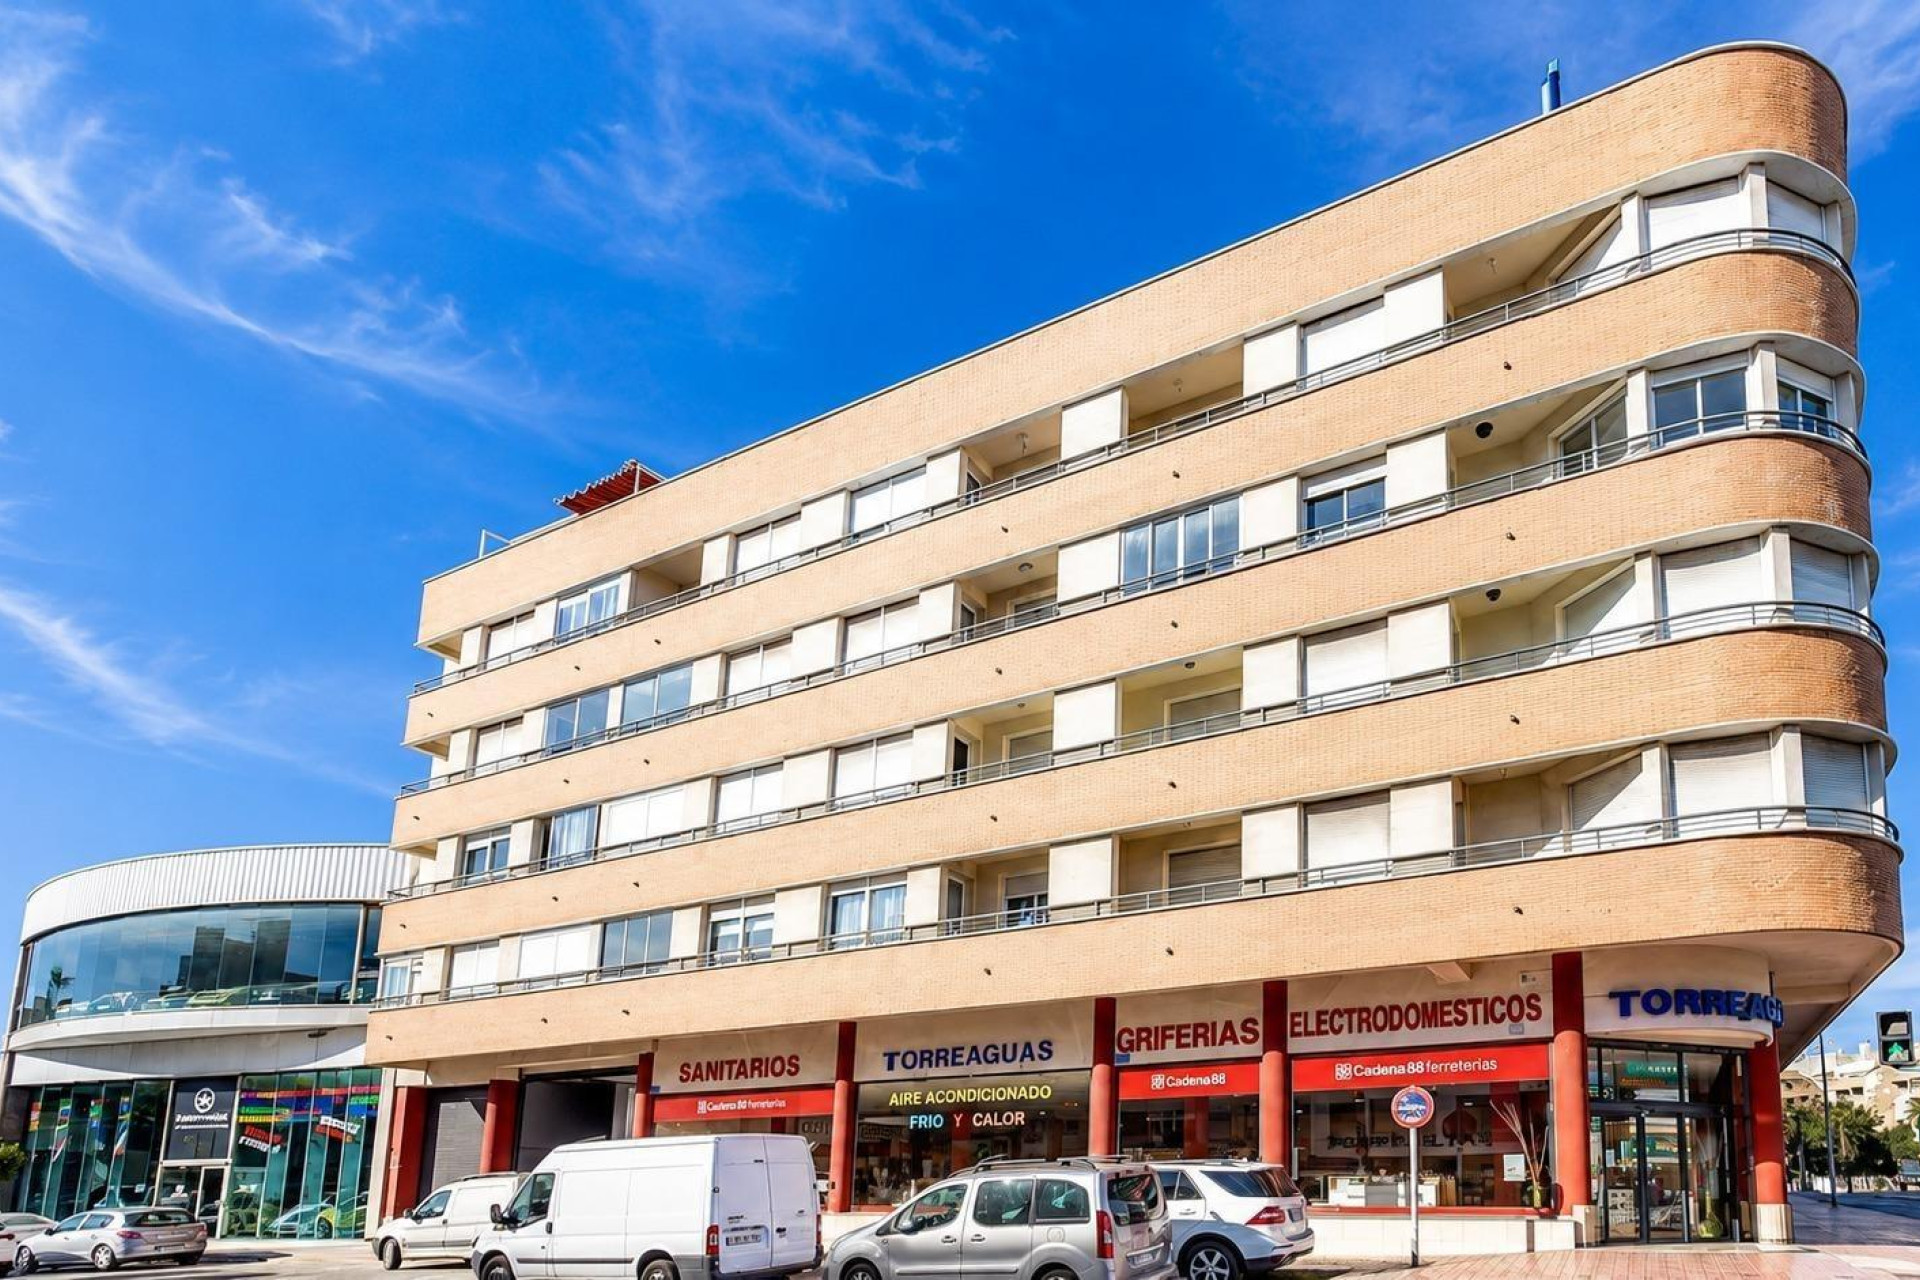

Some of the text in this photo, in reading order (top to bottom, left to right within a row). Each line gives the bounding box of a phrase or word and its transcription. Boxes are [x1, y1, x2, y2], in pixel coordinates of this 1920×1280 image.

[1289, 993, 1543, 1039] ELECTRODOMESTICOS
[1116, 1017, 1260, 1053] GRIFERIAS
[679, 1054, 801, 1083] SANITARIOS
[883, 1040, 1054, 1071] TORREAGUAS
[888, 1084, 1052, 1107] AIRE ACONDICIONADO
[909, 1111, 1025, 1130] FRIO Y CALOR
